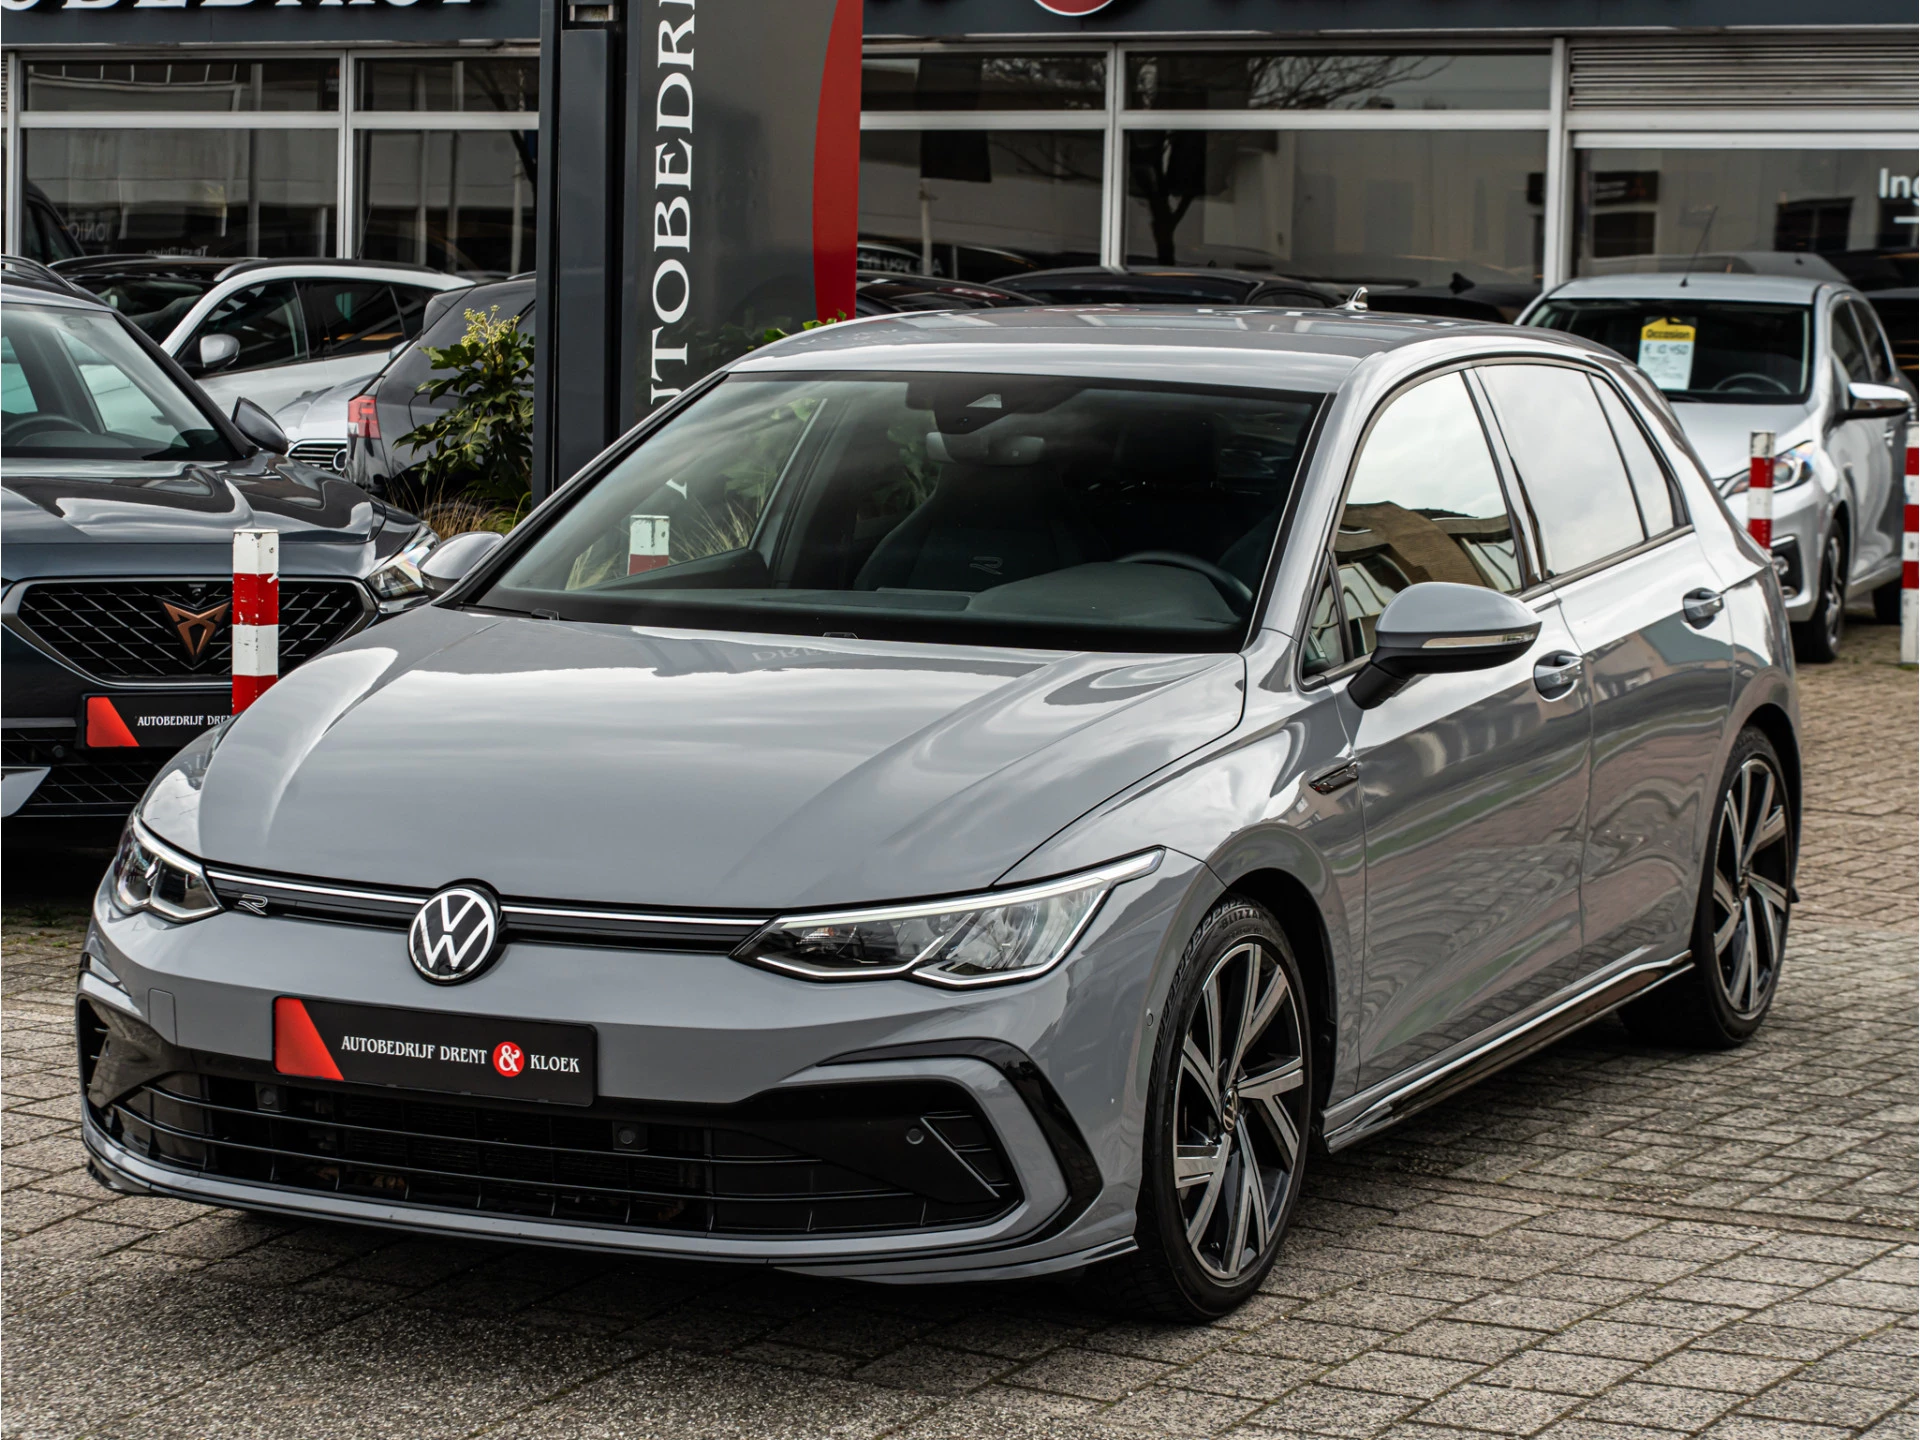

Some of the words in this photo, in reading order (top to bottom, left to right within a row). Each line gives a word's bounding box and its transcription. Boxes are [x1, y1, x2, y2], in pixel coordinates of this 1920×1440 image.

[648, 0, 695, 405] TOBEDR
[1646, 329, 1691, 339] Occasion
[137, 715, 204, 727] AUTOBEDRIJF
[207, 714, 232, 726] DRE
[340, 1034, 436, 1060] AUTOBEDRIJF
[439, 1045, 488, 1065] DRENT
[497, 1044, 522, 1073] &
[529, 1053, 581, 1074] KLOEK
